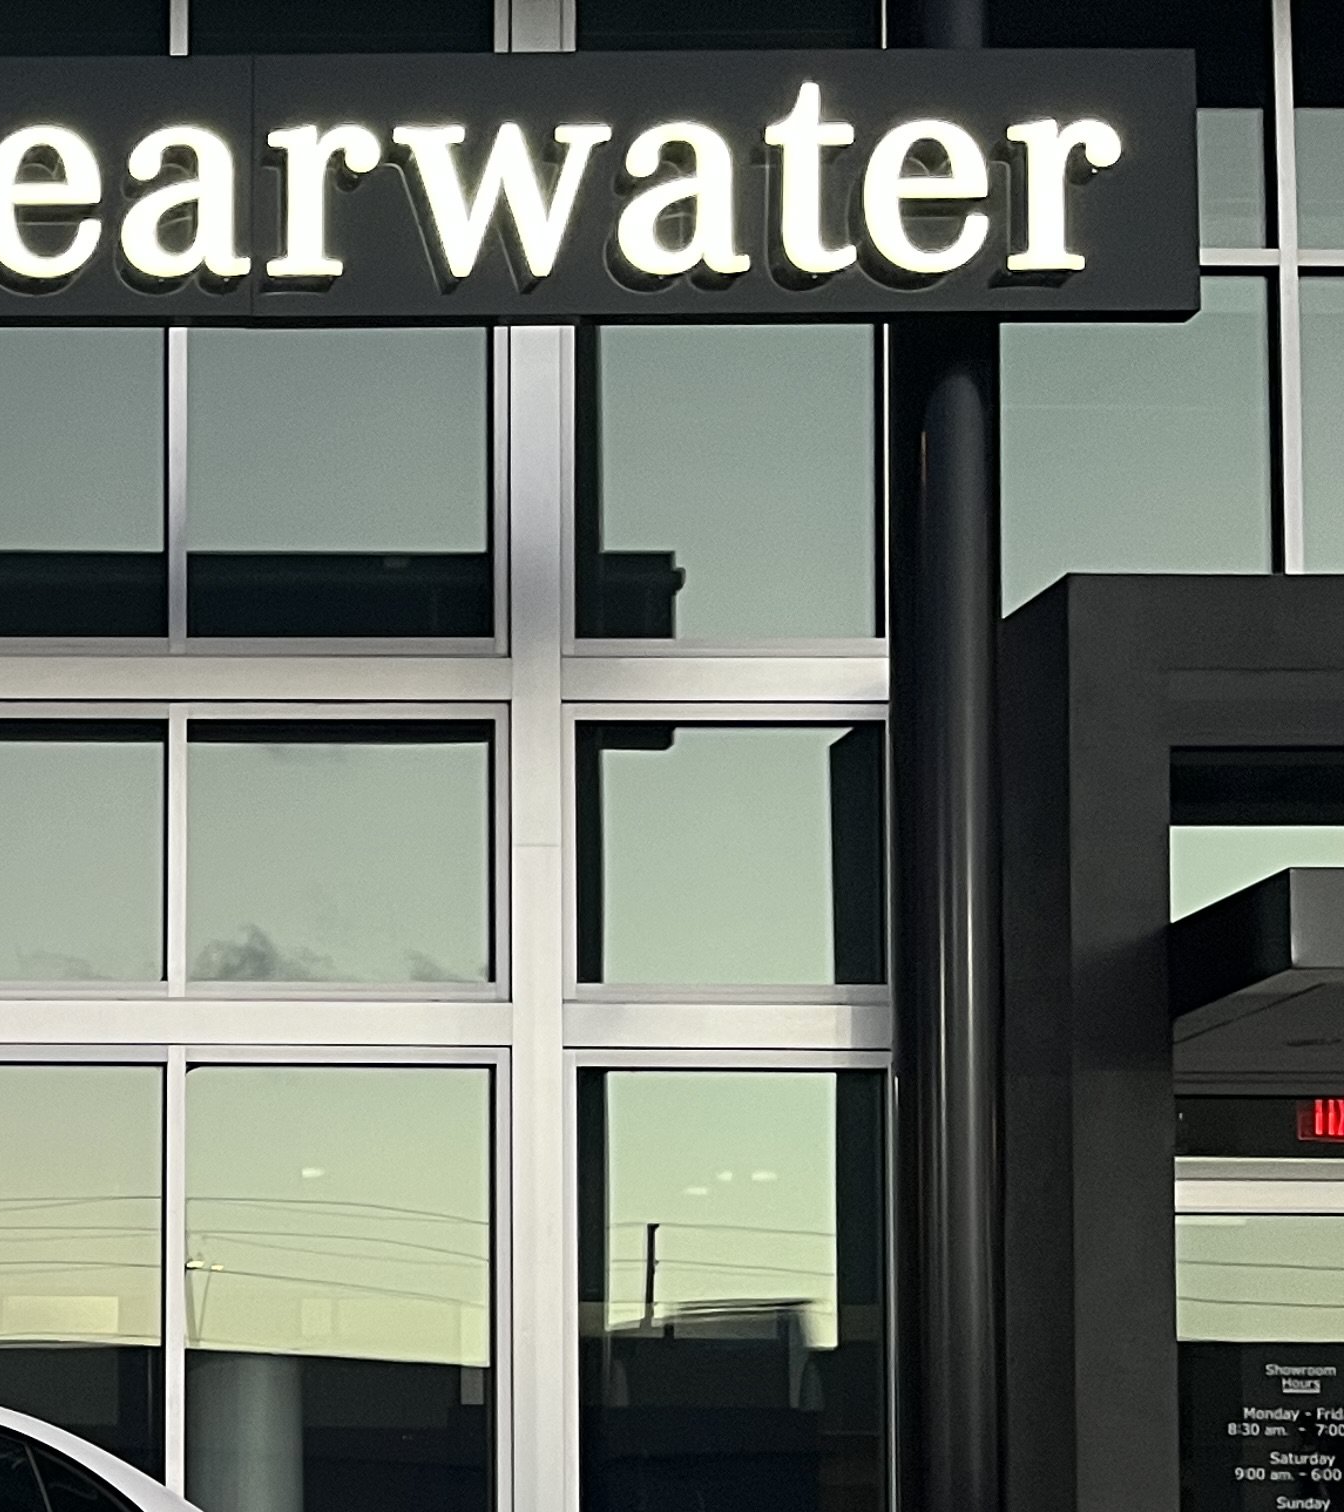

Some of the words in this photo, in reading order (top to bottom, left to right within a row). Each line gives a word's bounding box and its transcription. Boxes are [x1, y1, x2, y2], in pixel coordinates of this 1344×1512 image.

[1265, 1363, 1337, 1376] Showroom
[1281, 1378, 1320, 1391] Hours
[1243, 1407, 1300, 1422] Monday
[1316, 1407, 1344, 1420] Frid
[1227, 1422, 1260, 1436] 8:30
[1269, 1451, 1335, 1467] Saturday
[1276, 1496, 1331, 1512] Sunday
